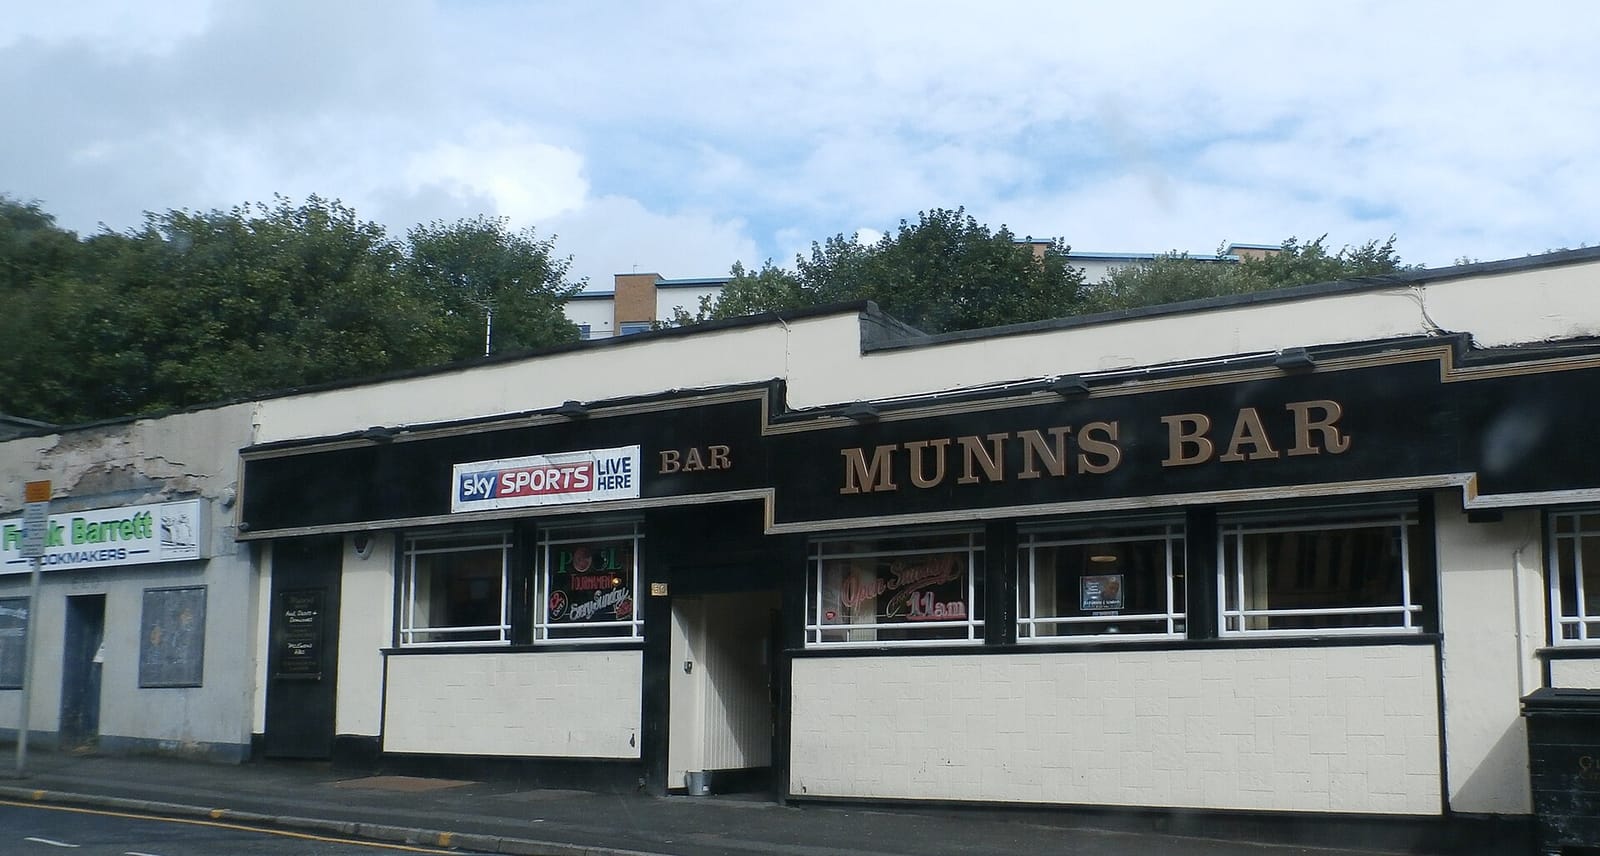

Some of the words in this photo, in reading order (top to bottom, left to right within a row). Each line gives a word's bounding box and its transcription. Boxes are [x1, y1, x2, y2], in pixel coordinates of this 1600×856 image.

[658, 444, 732, 474] BAR
[839, 421, 1122, 495] MUNNS
[1160, 399, 1352, 468] BAR
[597, 456, 632, 475] LIVE
[463, 474, 495, 498] sky
[500, 466, 590, 494] SPORTS
[597, 474, 632, 491] HERE
[71, 510, 153, 545] Barrett
[594, 587, 630, 610] Sunday
[906, 591, 966, 617] 11am
